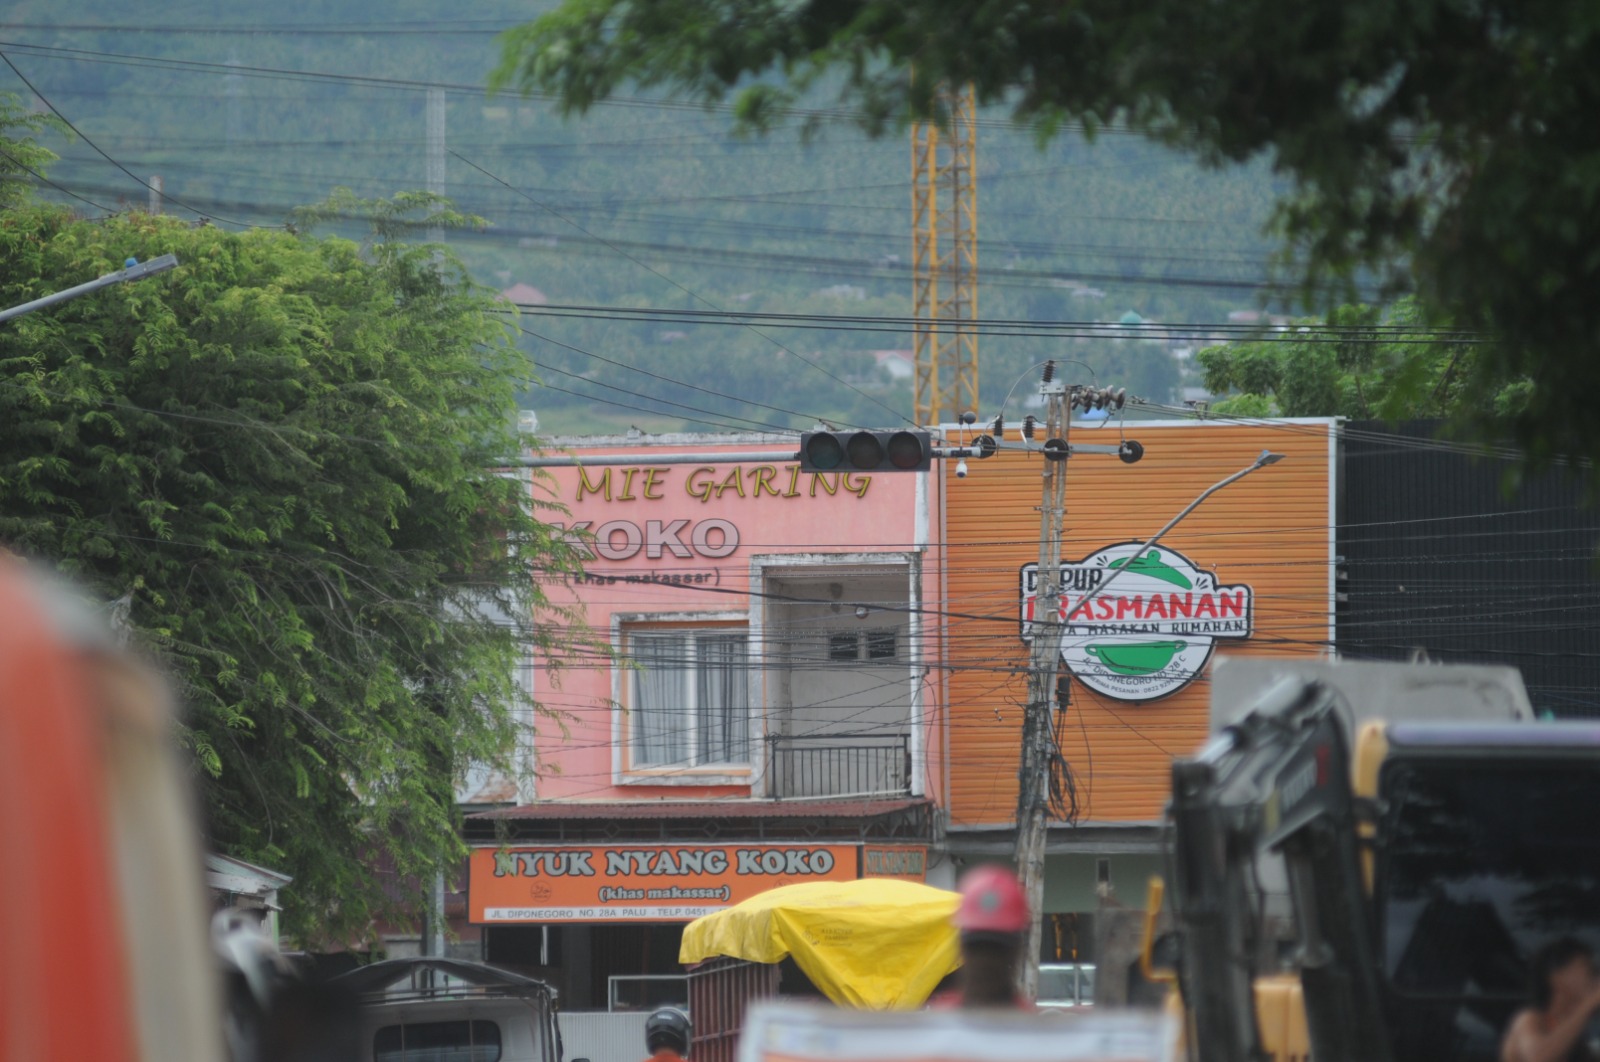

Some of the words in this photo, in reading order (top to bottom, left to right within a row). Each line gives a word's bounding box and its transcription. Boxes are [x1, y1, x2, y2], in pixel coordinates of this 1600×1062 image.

[575, 465, 672, 501] MIE
[685, 463, 873, 502] GARING
[549, 518, 740, 561] KOKO
[1027, 568, 1103, 592] DPUR
[1171, 620, 1243, 634] RUMAHAN
[492, 851, 596, 877] NYUK
[605, 850, 729, 877] NYANG
[736, 849, 835, 875] KOKO
[598, 885, 645, 902] (khas
[647, 884, 731, 902] makassar)
[508, 910, 573, 919] DIPONEGORO
[579, 909, 596, 917] NO.
[599, 909, 616, 917] 28A
[622, 908, 646, 917] PALU
[657, 908, 683, 917] TELP.
[685, 907, 707, 916] 0451
